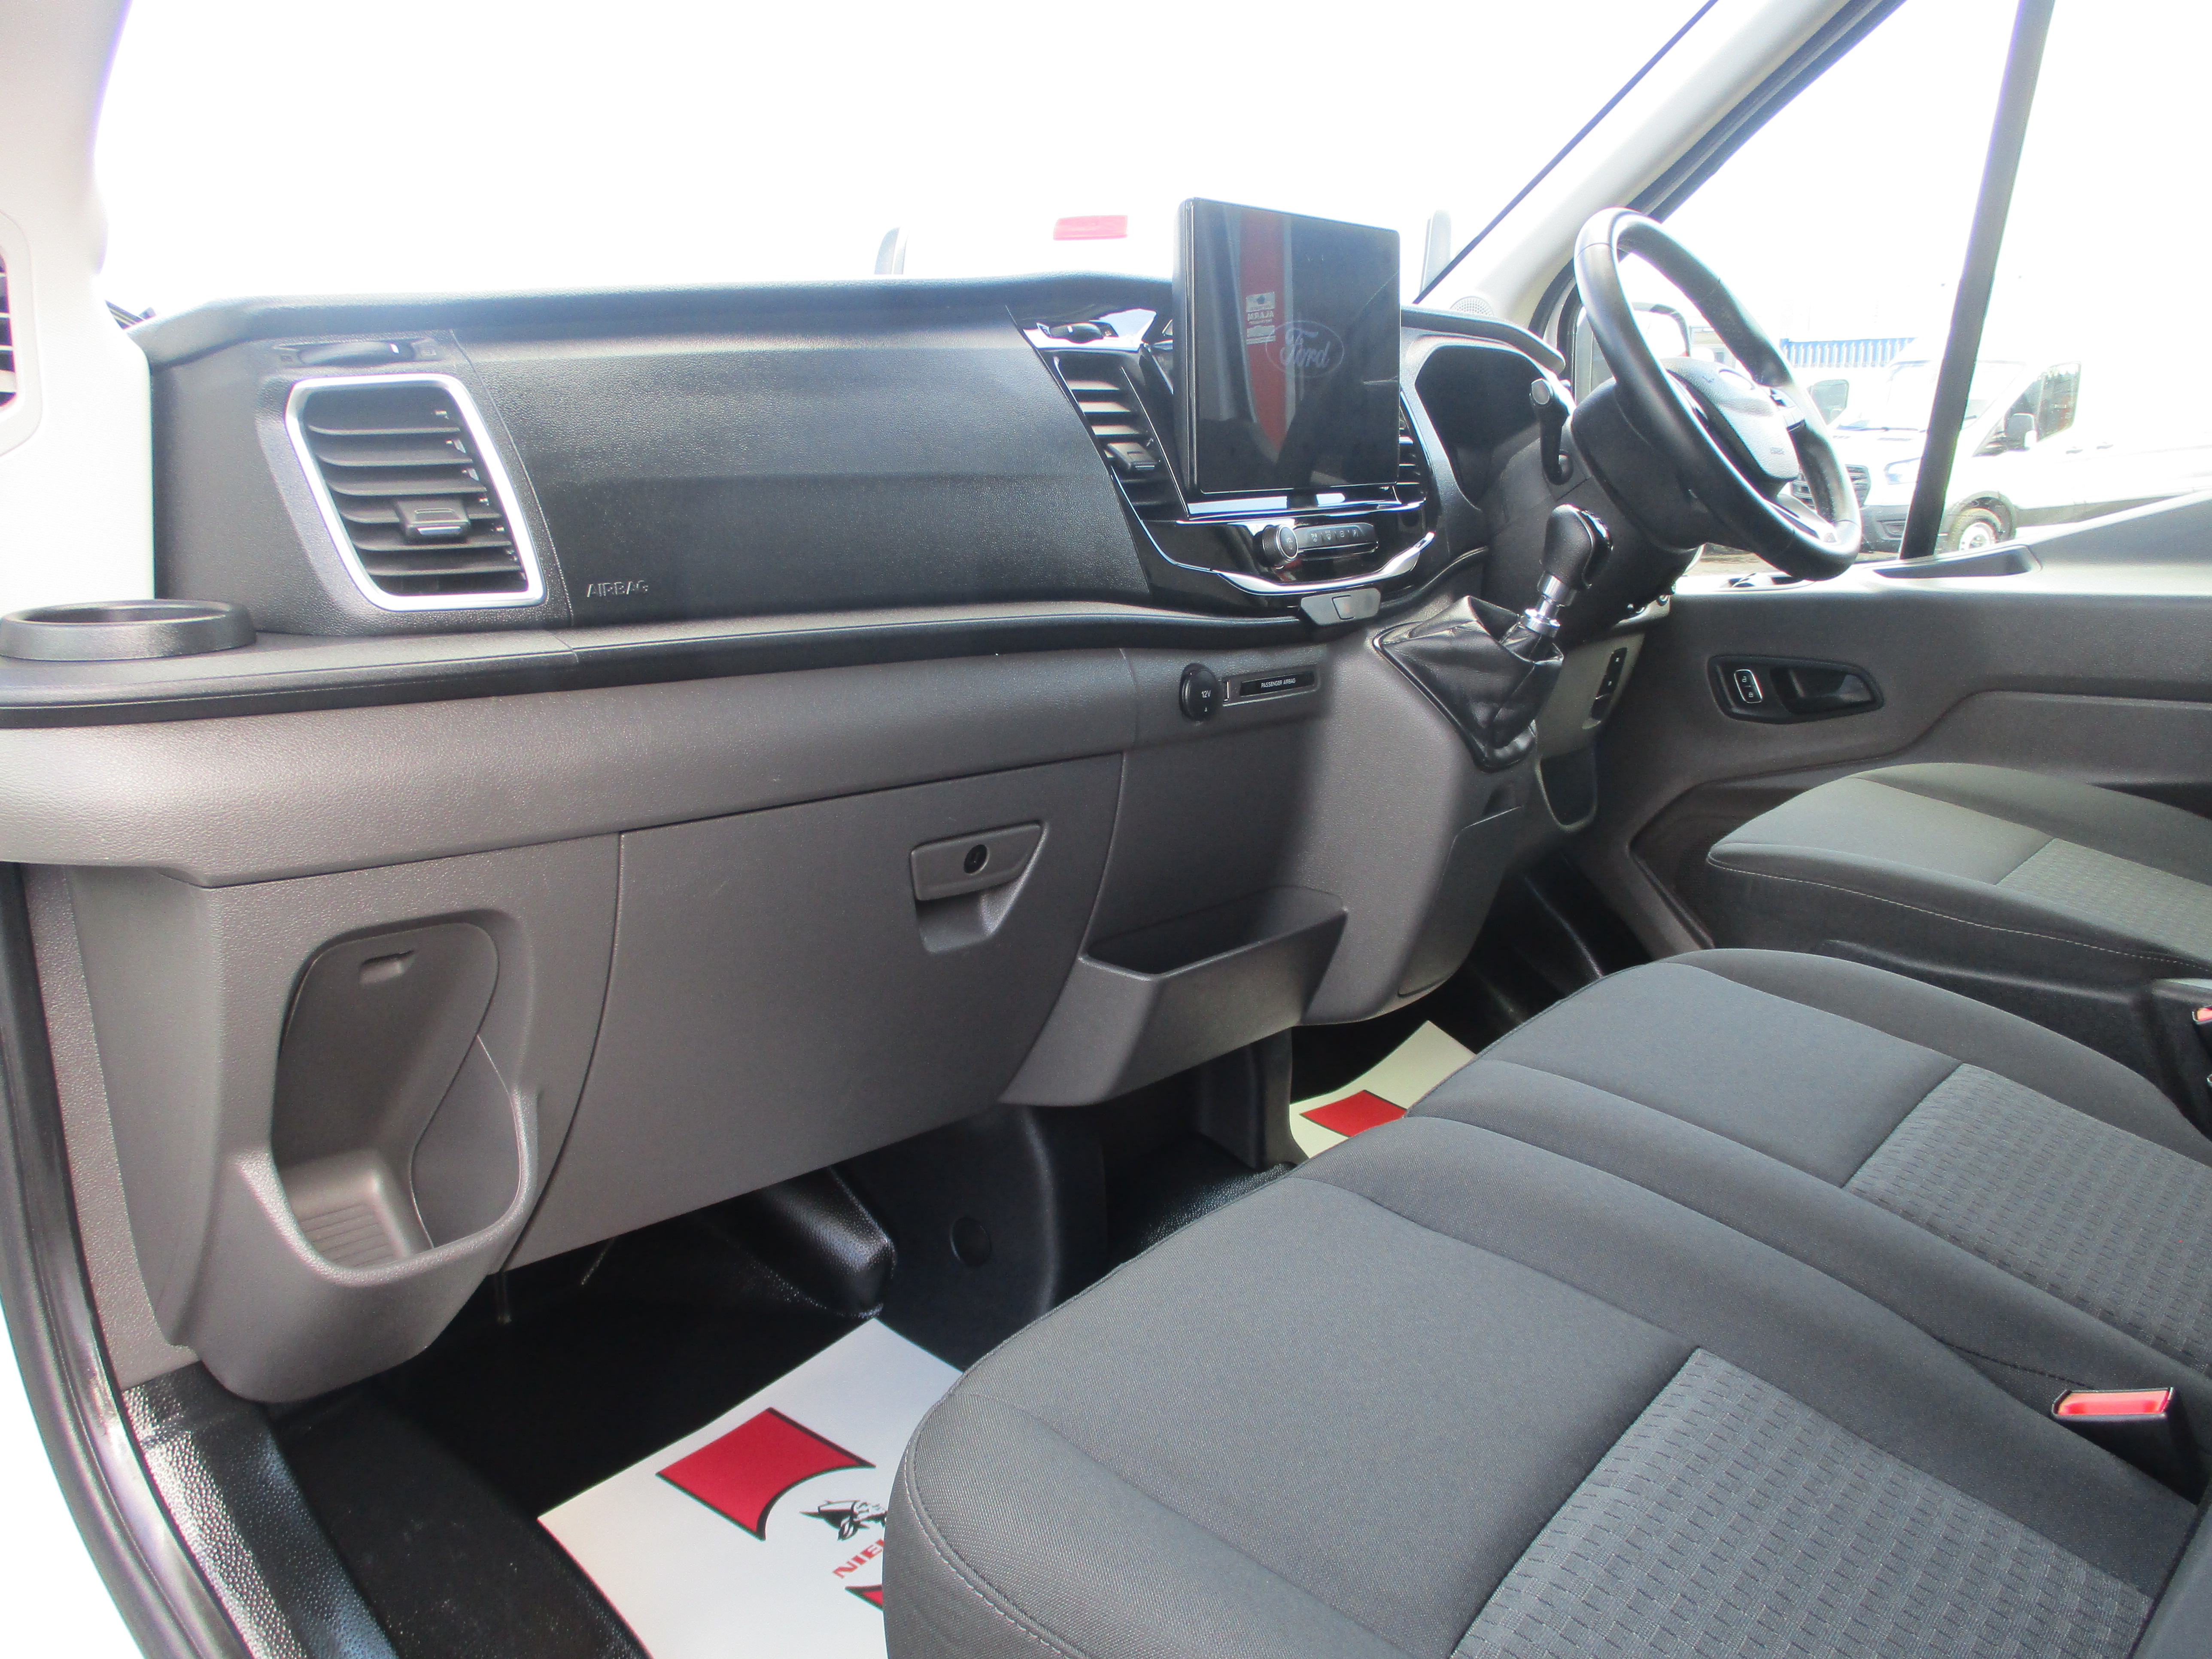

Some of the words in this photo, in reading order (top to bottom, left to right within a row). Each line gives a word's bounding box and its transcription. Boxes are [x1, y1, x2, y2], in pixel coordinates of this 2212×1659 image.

[1280, 328, 1330, 368] Ford
[586, 580, 648, 598] AIRBAG
[1261, 680, 1282, 688] PASSENGER
[1201, 690, 1211, 698] 12V
